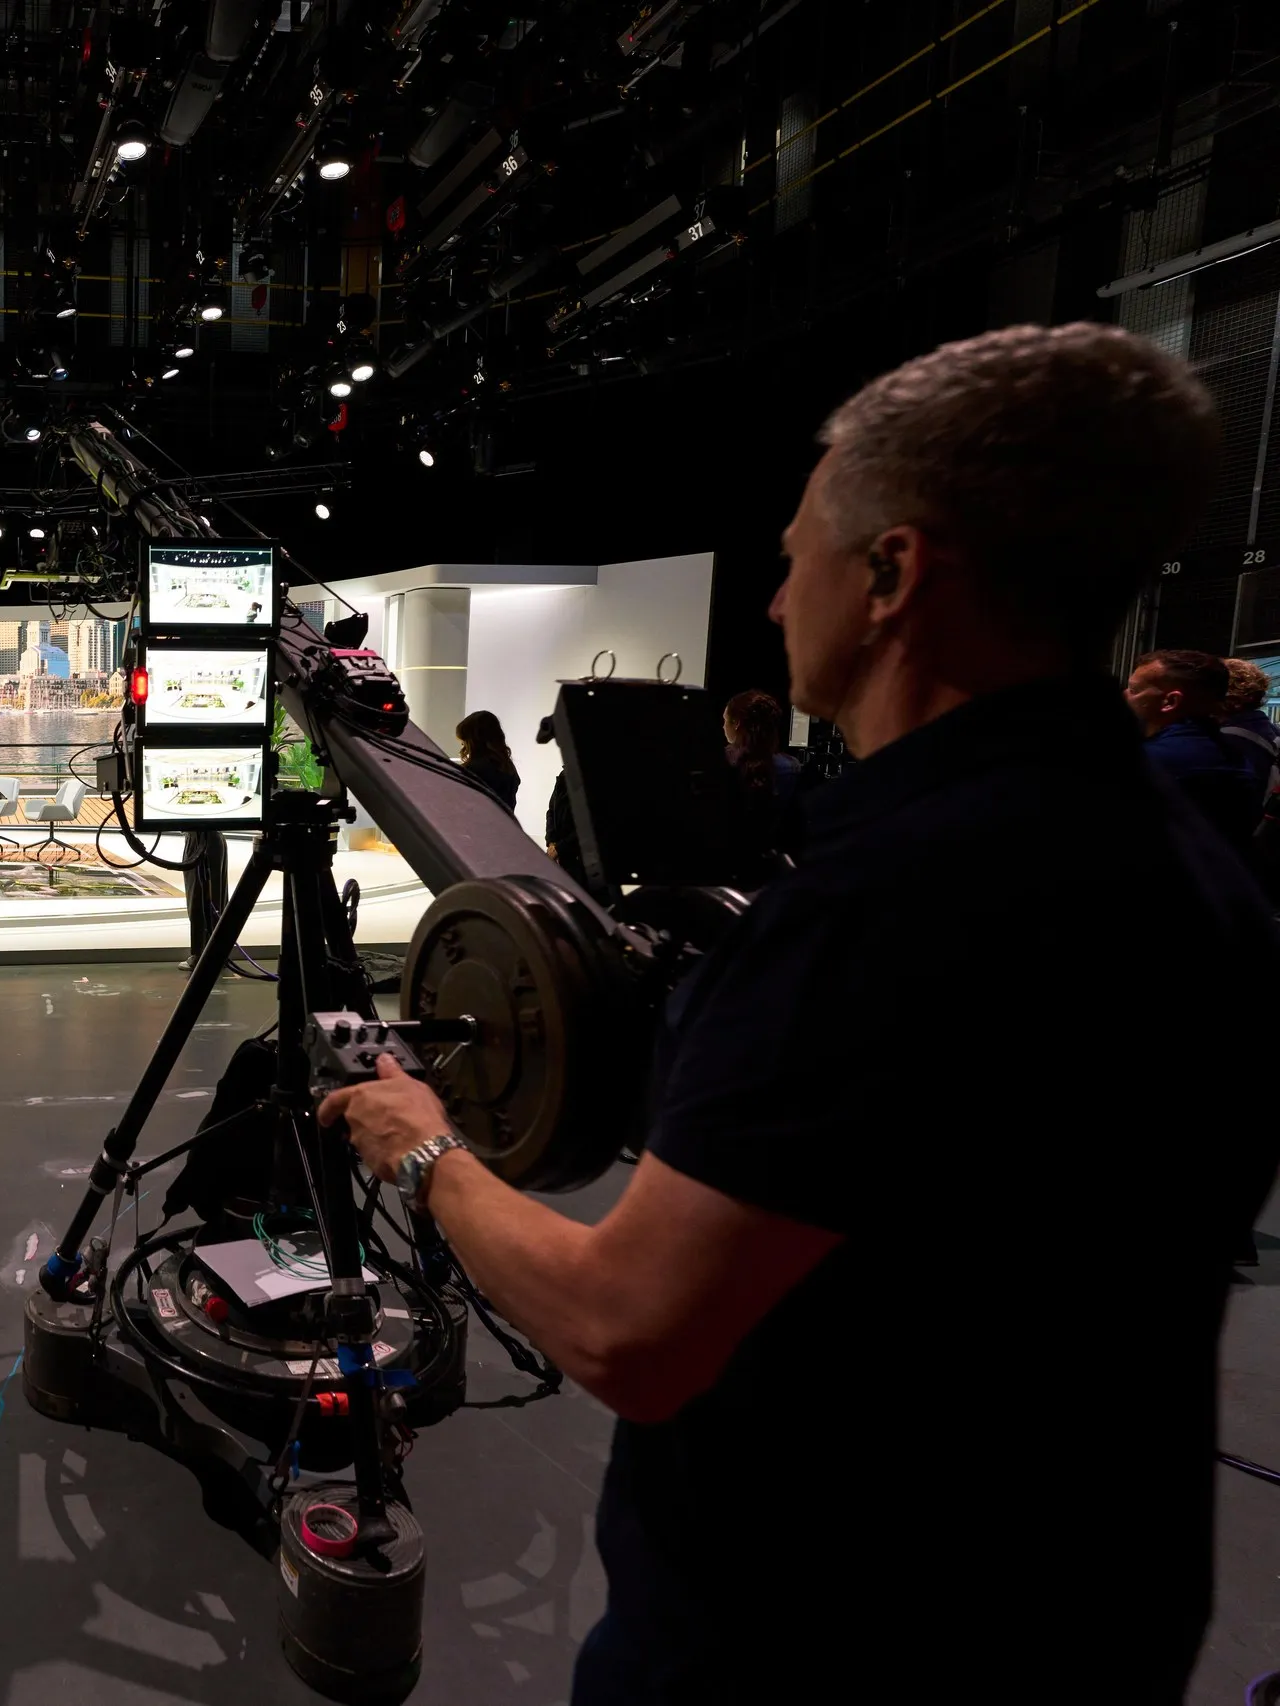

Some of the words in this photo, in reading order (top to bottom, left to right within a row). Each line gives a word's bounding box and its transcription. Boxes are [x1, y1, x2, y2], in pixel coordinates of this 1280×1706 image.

[310, 84, 323, 106] 35
[502, 155, 518, 176] 36
[688, 221, 704, 241] 37
[473, 371, 485, 385] 24
[1242, 549, 1266, 565] 28
[1161, 561, 1181, 575] 30
